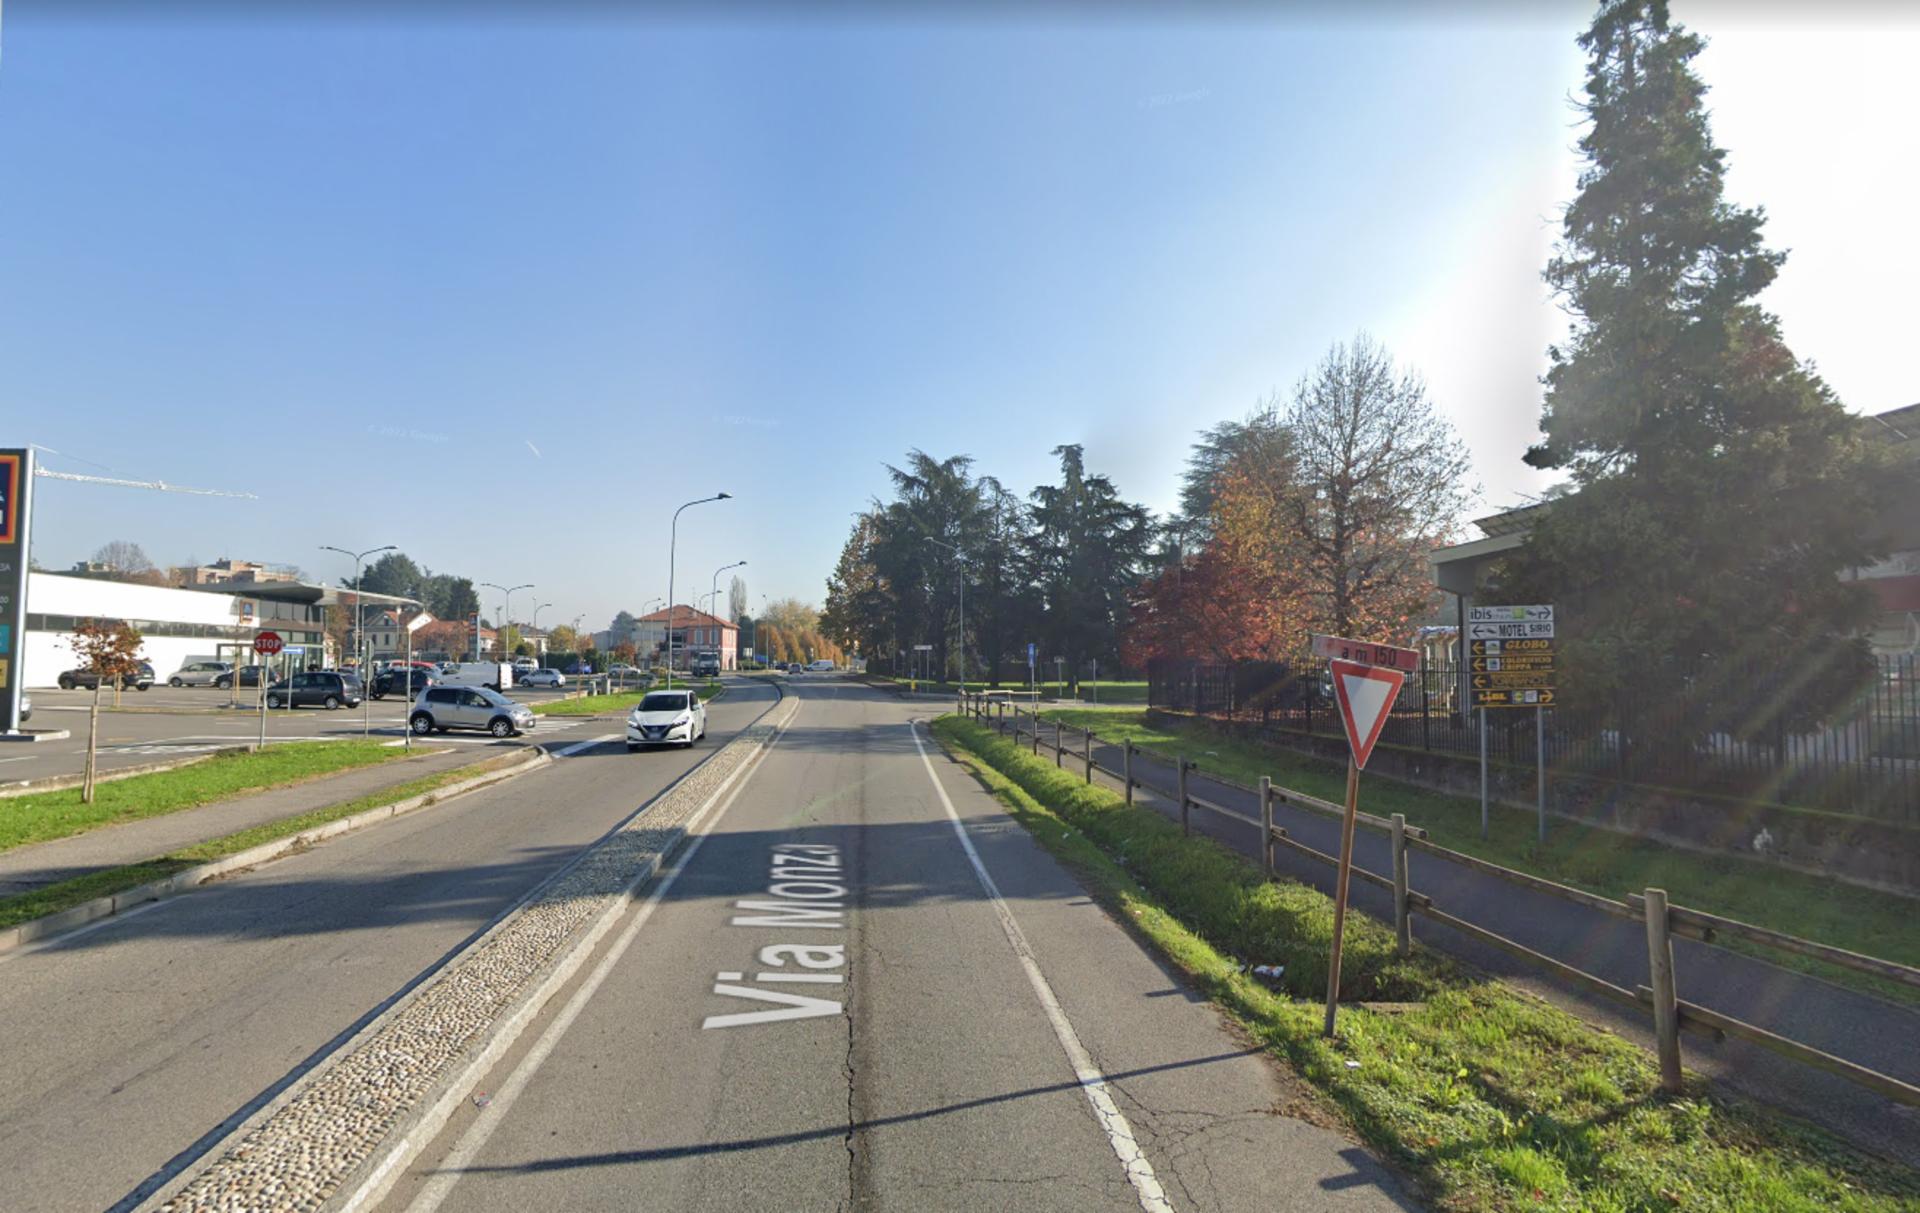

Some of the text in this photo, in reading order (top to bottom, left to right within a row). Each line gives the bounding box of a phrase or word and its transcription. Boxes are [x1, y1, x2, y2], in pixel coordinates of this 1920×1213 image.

[1470, 607, 1493, 620] ibis
[1499, 623, 1552, 637] MOTEL SIRIO
[255, 638, 281, 649] STOP
[1504, 639, 1550, 650] GLOBO
[1374, 646, 1397, 666] 150
